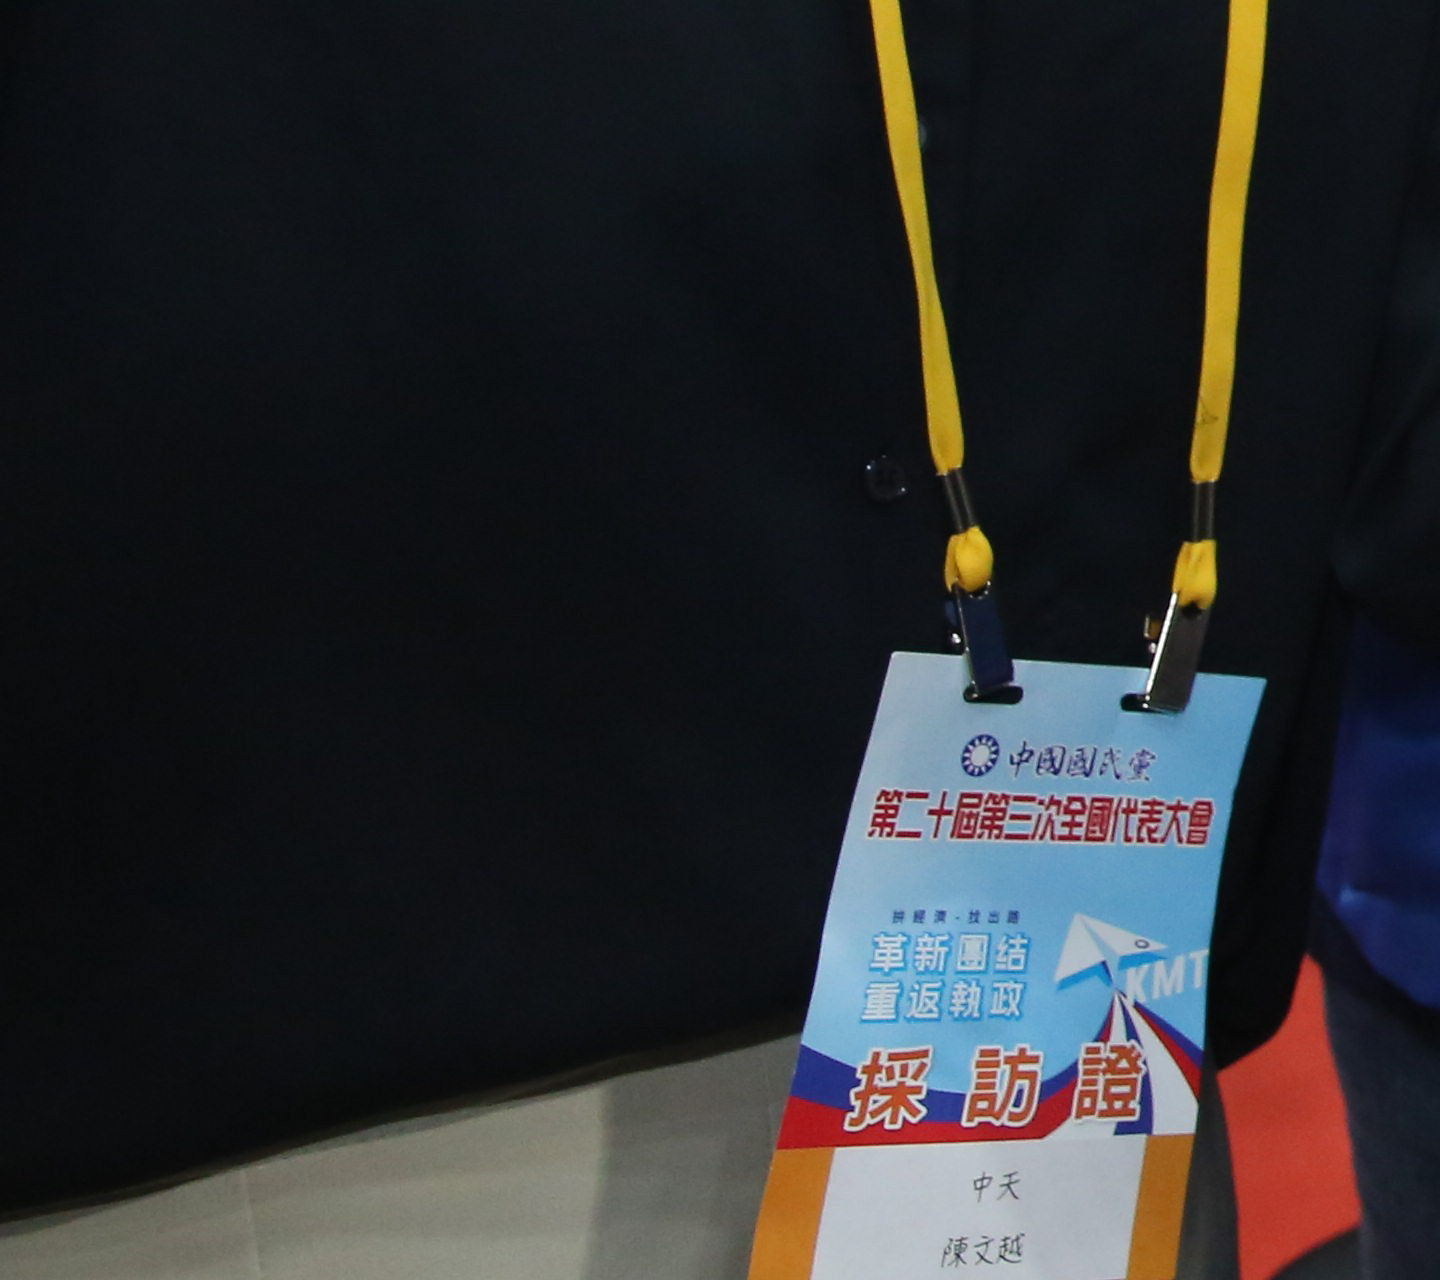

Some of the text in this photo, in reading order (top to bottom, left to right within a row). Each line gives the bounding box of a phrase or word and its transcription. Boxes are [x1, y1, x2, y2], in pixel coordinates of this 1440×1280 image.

[1009, 740, 1158, 782] 中國國民黨
[867, 789, 1215, 846] 第二十屆第三次全國代表大會
[868, 933, 1030, 973] 革新團結
[1125, 948, 1209, 1005] KMT
[860, 981, 1026, 1022] 重返執政
[845, 1042, 1145, 1130] 採訪證
[972, 1171, 1021, 1202] 中天
